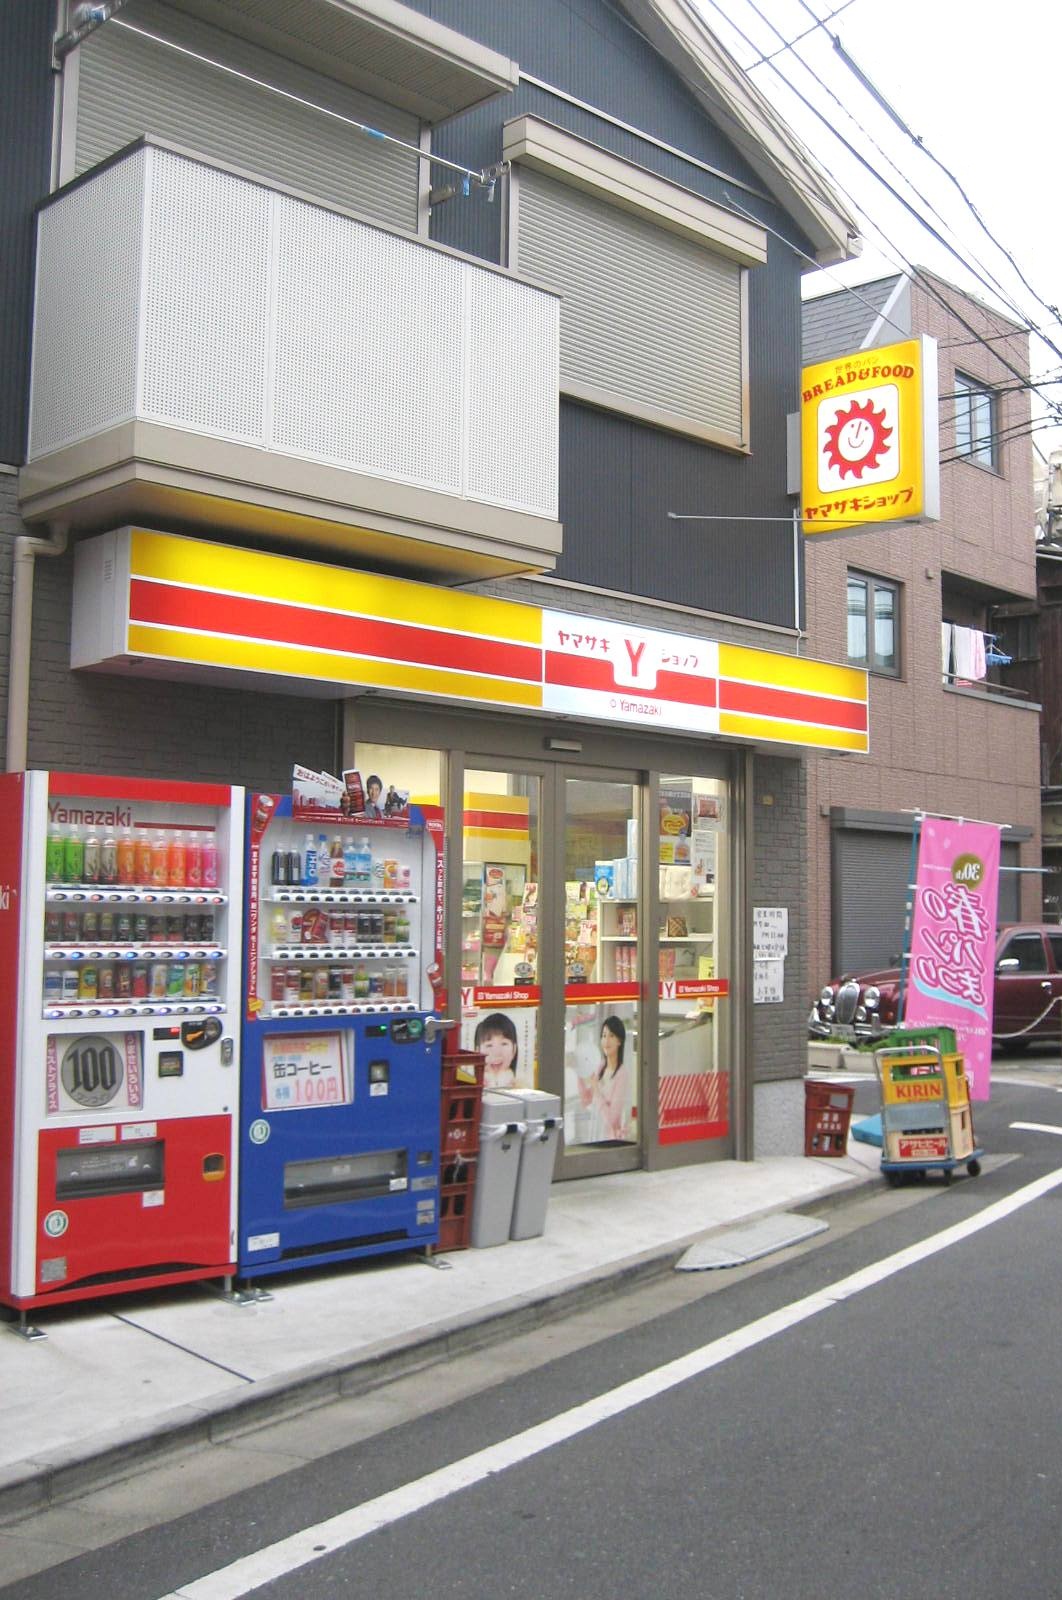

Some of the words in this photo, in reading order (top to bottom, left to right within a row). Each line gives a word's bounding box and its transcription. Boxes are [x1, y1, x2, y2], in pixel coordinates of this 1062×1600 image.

[801, 364, 915, 403] BREAD&FOOD
[623, 638, 647, 678] Y
[619, 698, 663, 717] Yamazaki
[47, 801, 132, 828] Yamazaki
[67, 1046, 116, 1093] 100
[274, 1060, 332, 1080] 缶コーヒー
[294, 1076, 338, 1103] 100円
[895, 1083, 942, 1099] KIRIN
